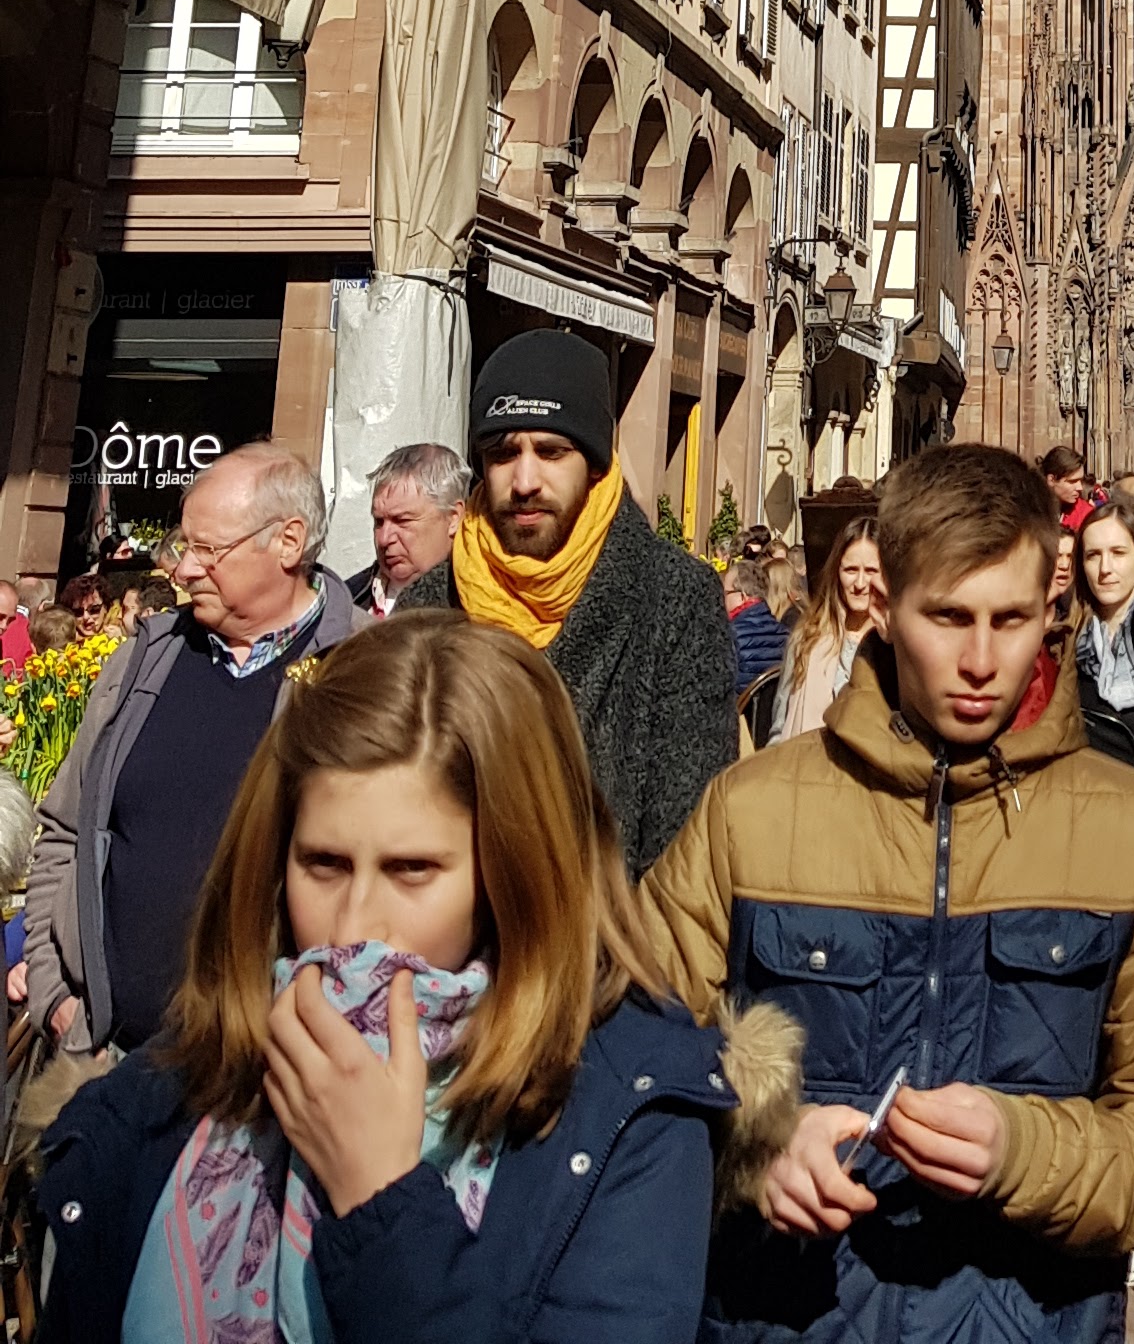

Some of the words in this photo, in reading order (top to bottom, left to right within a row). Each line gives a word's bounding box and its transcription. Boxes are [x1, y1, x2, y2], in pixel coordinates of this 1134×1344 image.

[177, 288, 255, 315] glacier
[68, 469, 138, 486] estaurant
[155, 468, 198, 490] glaci
